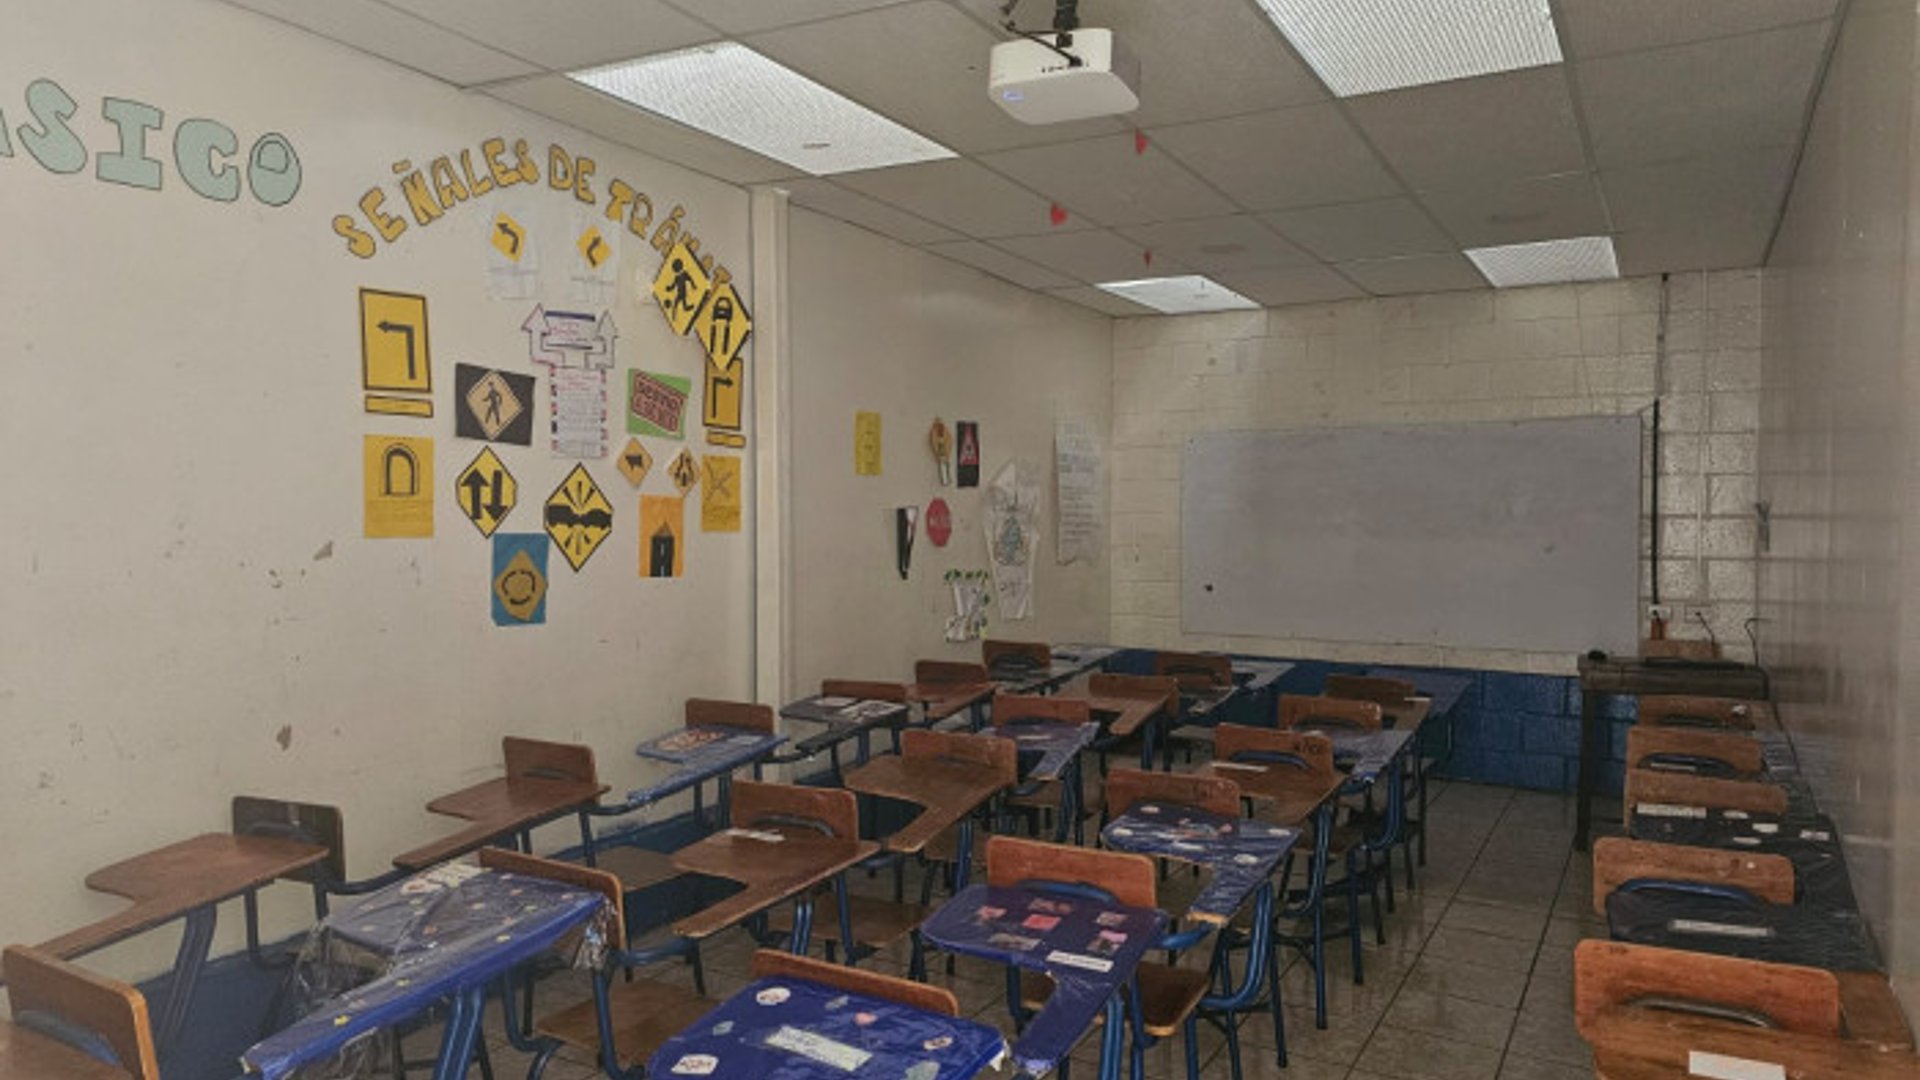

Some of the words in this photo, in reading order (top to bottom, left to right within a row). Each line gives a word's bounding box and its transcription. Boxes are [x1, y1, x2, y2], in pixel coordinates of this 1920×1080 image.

[0, 78, 302, 206] SICO
[332, 137, 540, 259] SEÑALES
[548, 143, 596, 204] DE
